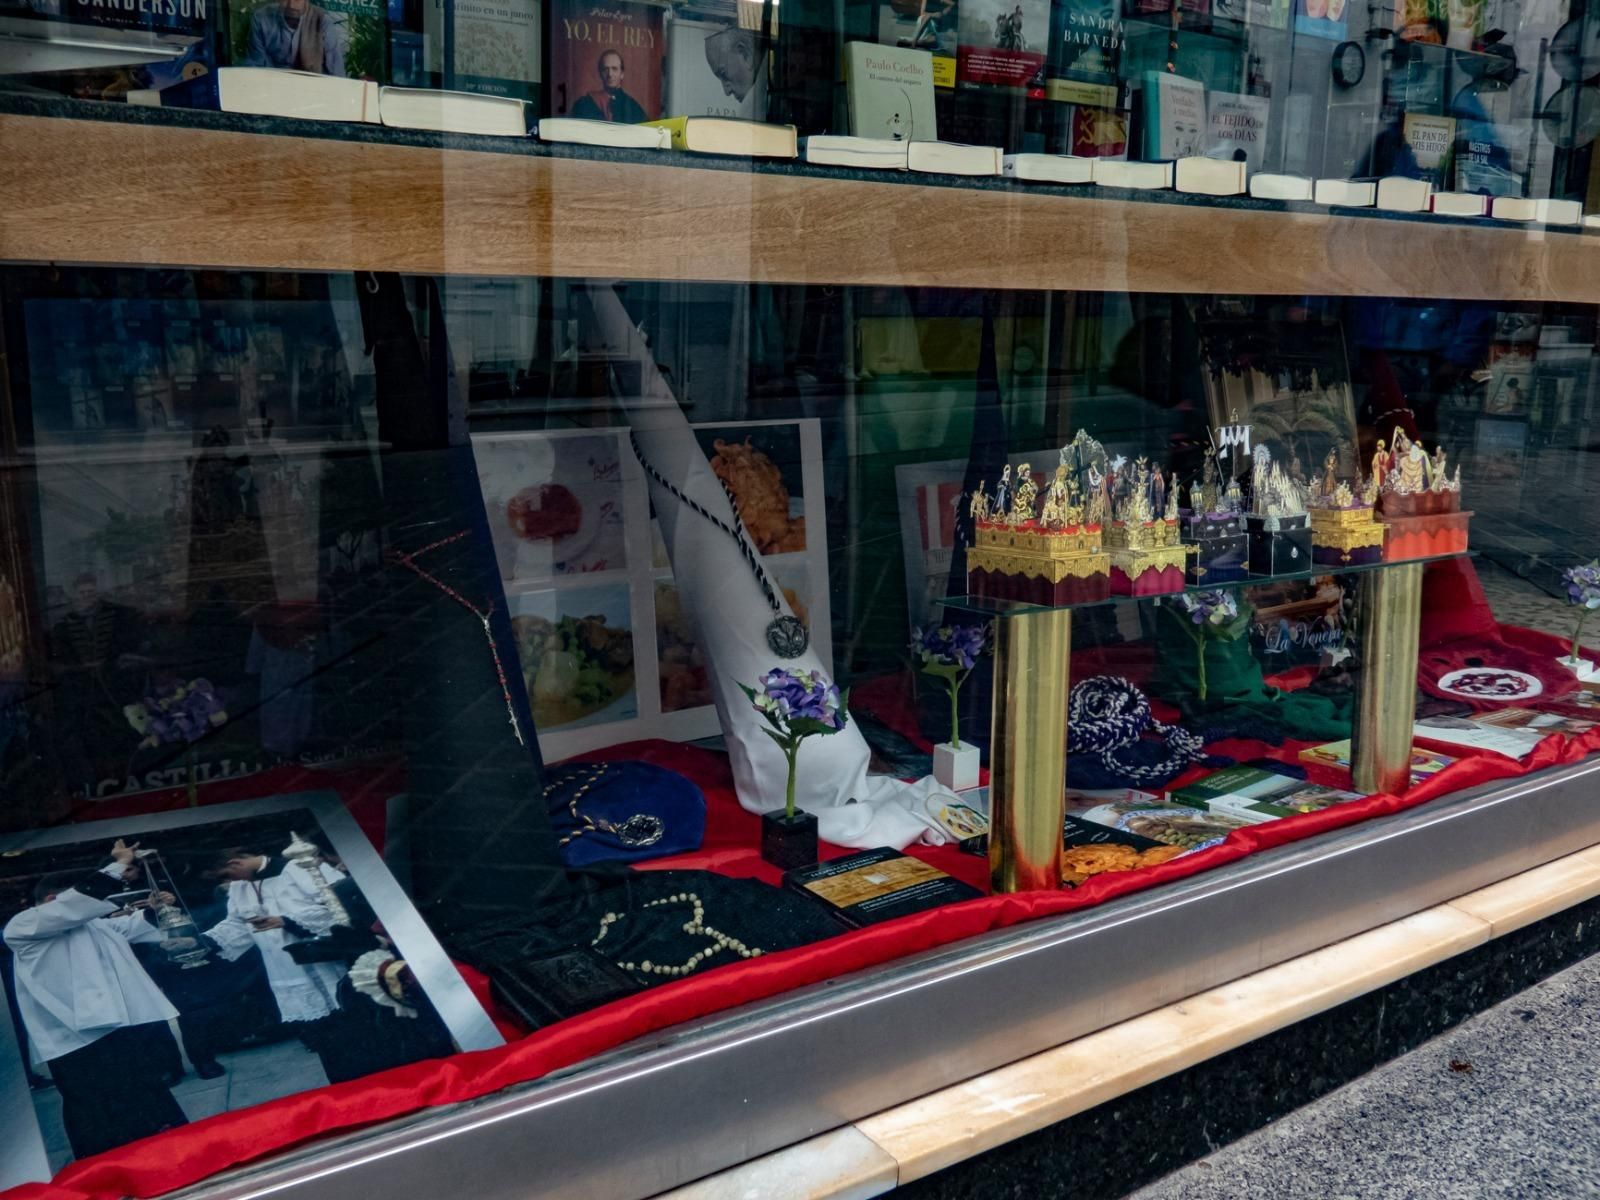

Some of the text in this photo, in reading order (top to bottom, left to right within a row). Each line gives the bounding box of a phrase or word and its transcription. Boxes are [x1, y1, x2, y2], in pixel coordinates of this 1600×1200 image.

[1069, 12, 1124, 33] SANDRA
[624, 25, 655, 48] REY
[1063, 29, 1127, 52] BARNEDA
[866, 57, 892, 71] Paulo
[893, 62, 925, 75] Coelho
[1223, 113, 1256, 129] TEJIDO
[1423, 131, 1437, 142] PAN
[1426, 142, 1447, 154] HIJOS
